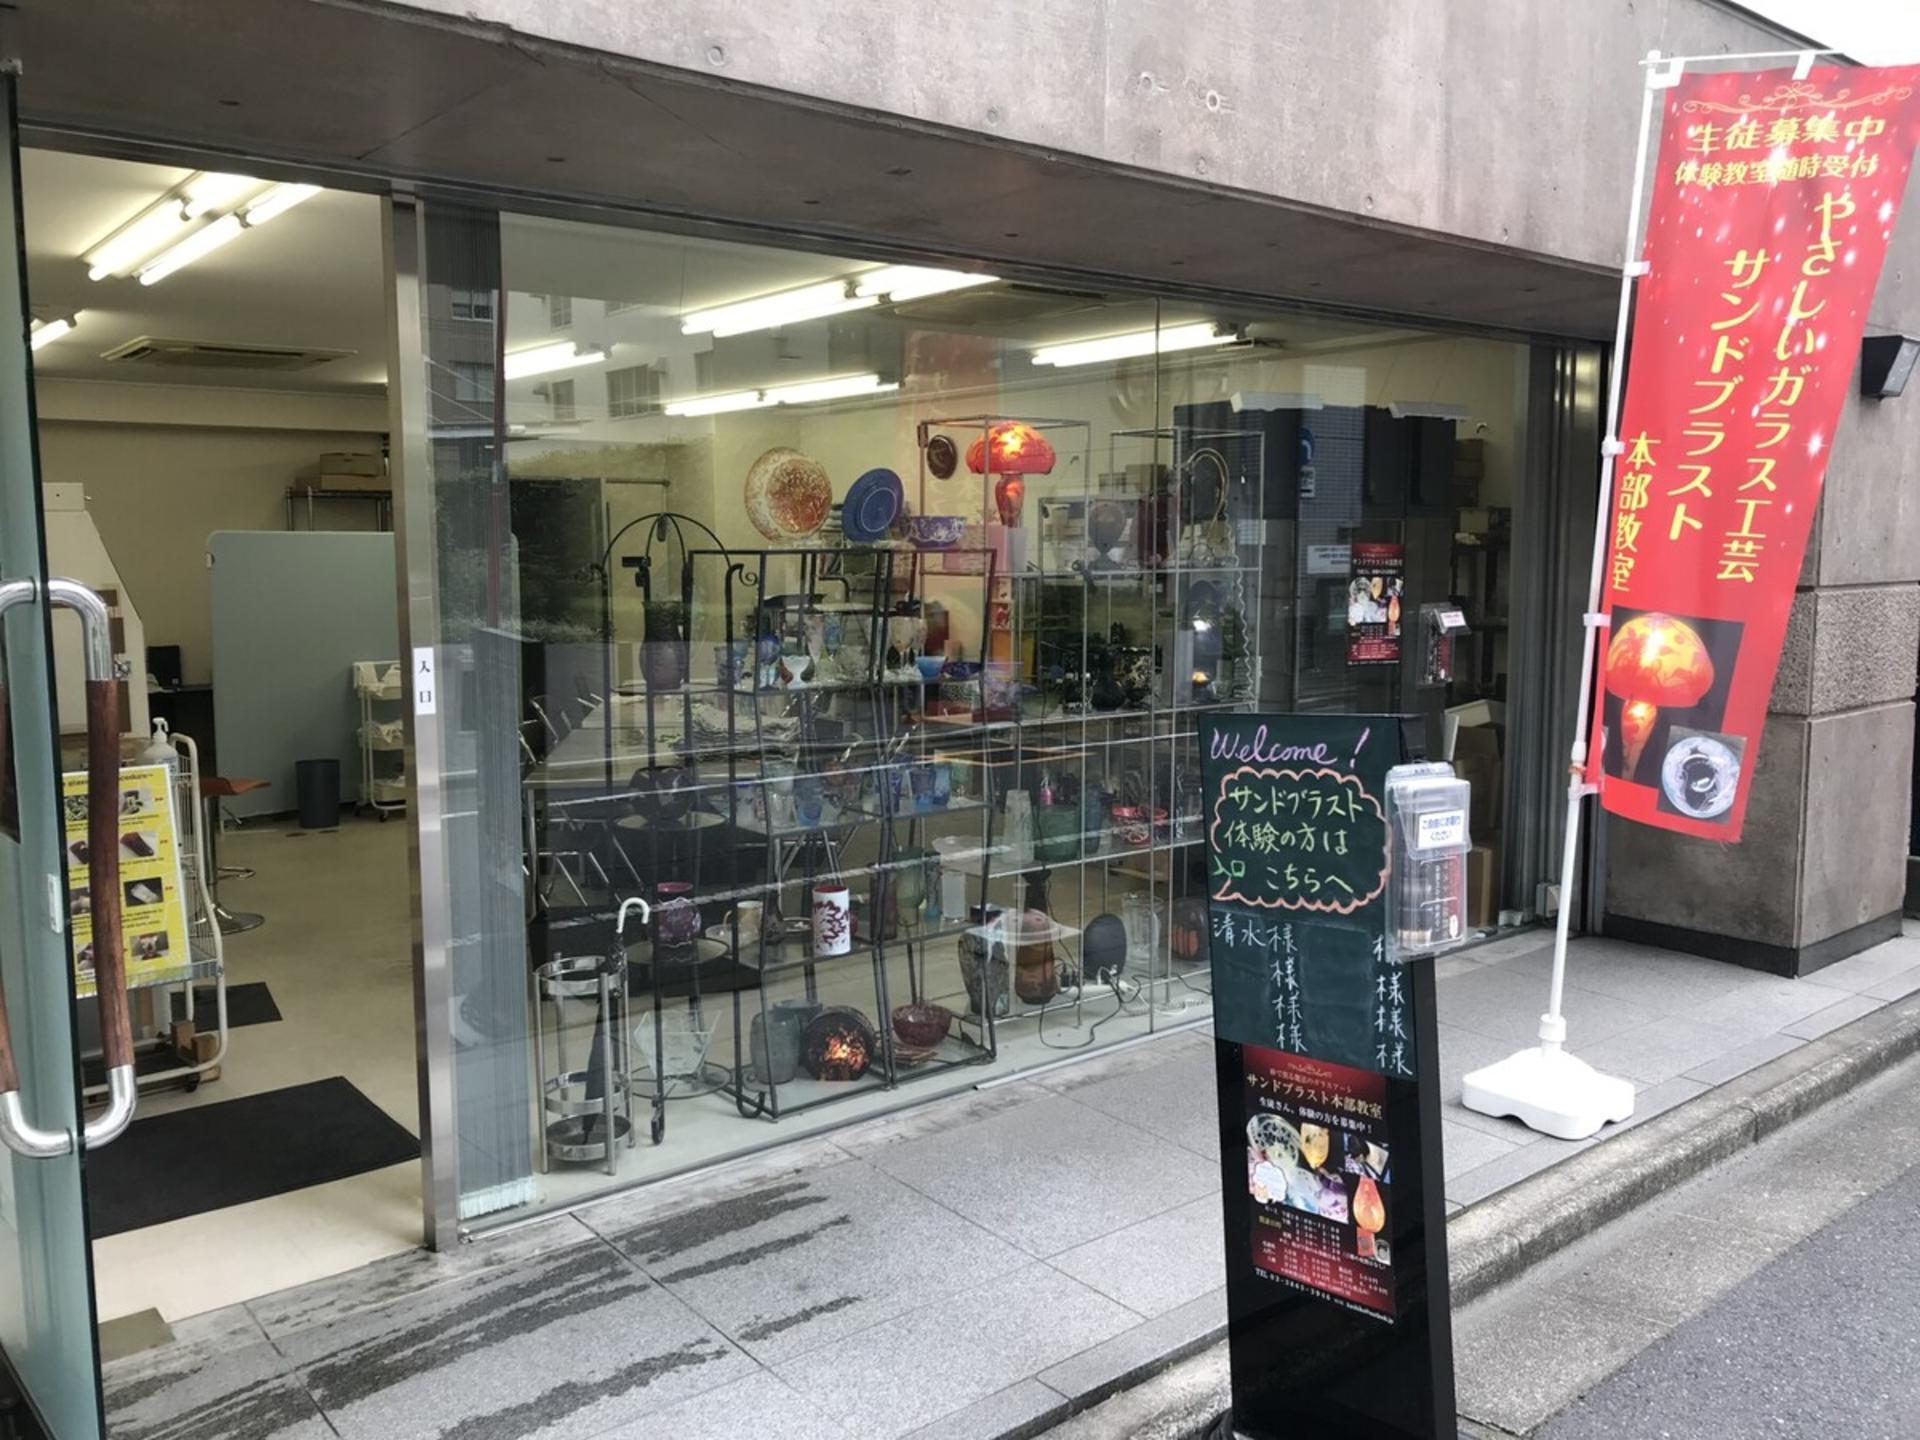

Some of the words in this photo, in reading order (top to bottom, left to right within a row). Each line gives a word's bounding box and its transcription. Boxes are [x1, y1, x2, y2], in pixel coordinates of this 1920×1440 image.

[1687, 115, 1886, 156] 生徒募集中
[1675, 153, 1879, 187] 体験教室随時受付
[1667, 248, 1770, 541] サンドブラスト
[1717, 191, 1857, 583] やさしいガラス工芸
[1612, 431, 1662, 592] 本部教室
[418, 660, 433, 704] 入口
[1210, 724, 1338, 765] Welcome
[1228, 786, 1364, 823] サンドブラスト
[1223, 819, 1349, 856] 体験の方は
[1211, 855, 1246, 878] 入口
[1266, 863, 1355, 894] こちらへ
[1213, 912, 1299, 953] 清水様
[1246, 1073, 1383, 1119] サンドブラスト本部教室
